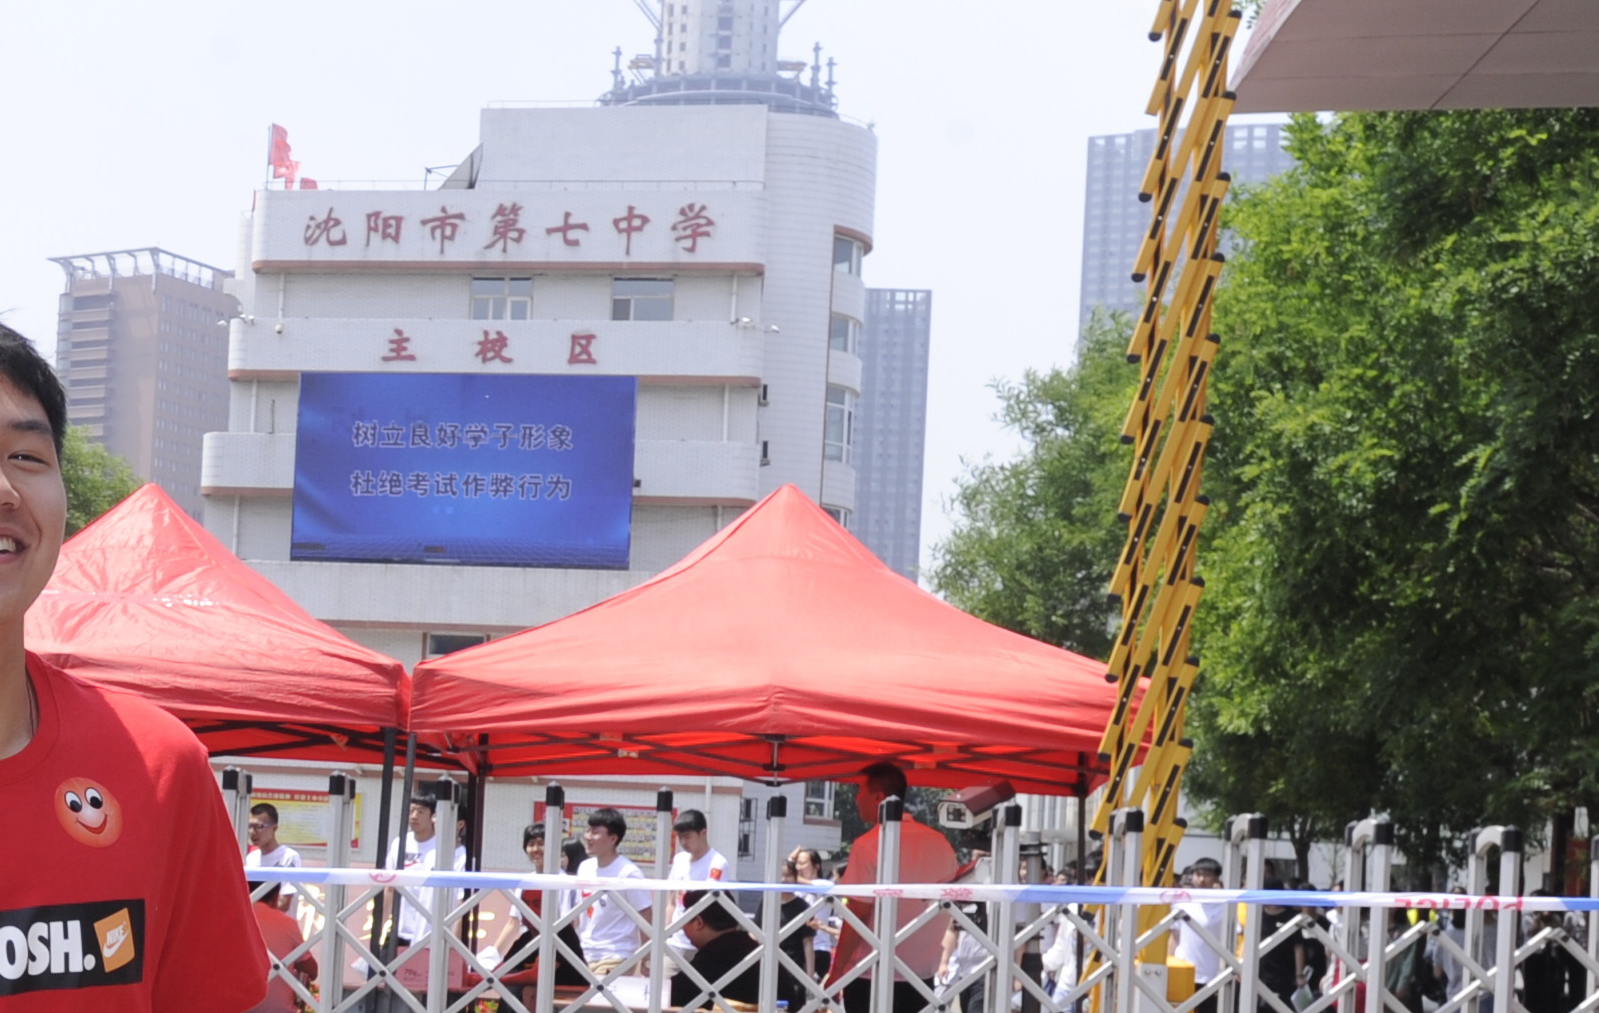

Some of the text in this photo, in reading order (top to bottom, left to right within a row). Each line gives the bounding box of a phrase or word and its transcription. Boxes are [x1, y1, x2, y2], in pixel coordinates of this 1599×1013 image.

[303, 202, 716, 256] 沈阳市第七中学
[381, 328, 598, 366] 主校区
[352, 421, 574, 450] 树立良好学子形象
[351, 470, 572, 500] 杜绝考试作弊行为
